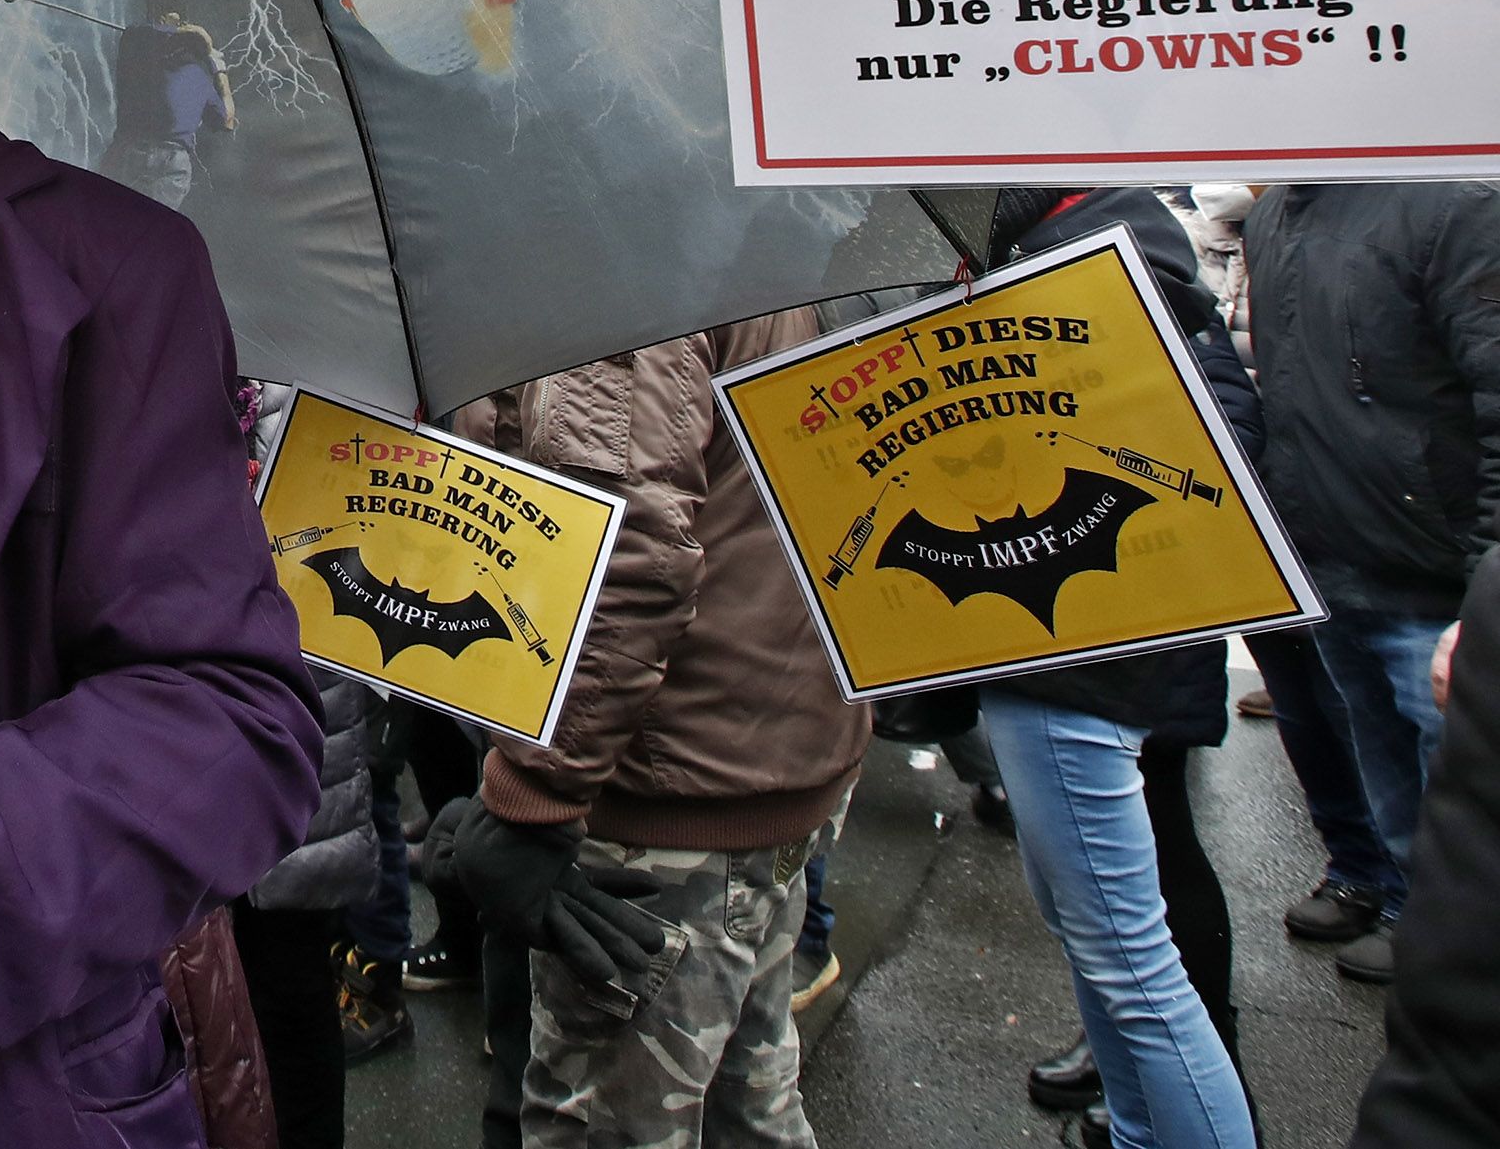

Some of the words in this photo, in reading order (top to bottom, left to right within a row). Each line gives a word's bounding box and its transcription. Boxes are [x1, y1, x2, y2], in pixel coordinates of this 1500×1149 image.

[856, 49, 962, 83] nur
[931, 315, 1091, 354] DIESE
[853, 374, 931, 432] BAD
[940, 353, 1038, 393] MAN
[855, 390, 1081, 479] REGIERUNG
[345, 495, 518, 572] REGIERUNG
[368, 468, 436, 496] BAD
[442, 485, 516, 536] MAN
[458, 463, 563, 542] DIESE
[904, 540, 975, 569] STOPPT
[978, 526, 1060, 569] IMPF
[1061, 491, 1118, 546] ZWANG
[329, 560, 374, 604] STOPPT
[373, 592, 440, 629] IMPF
[438, 617, 491, 632] ZWANG
